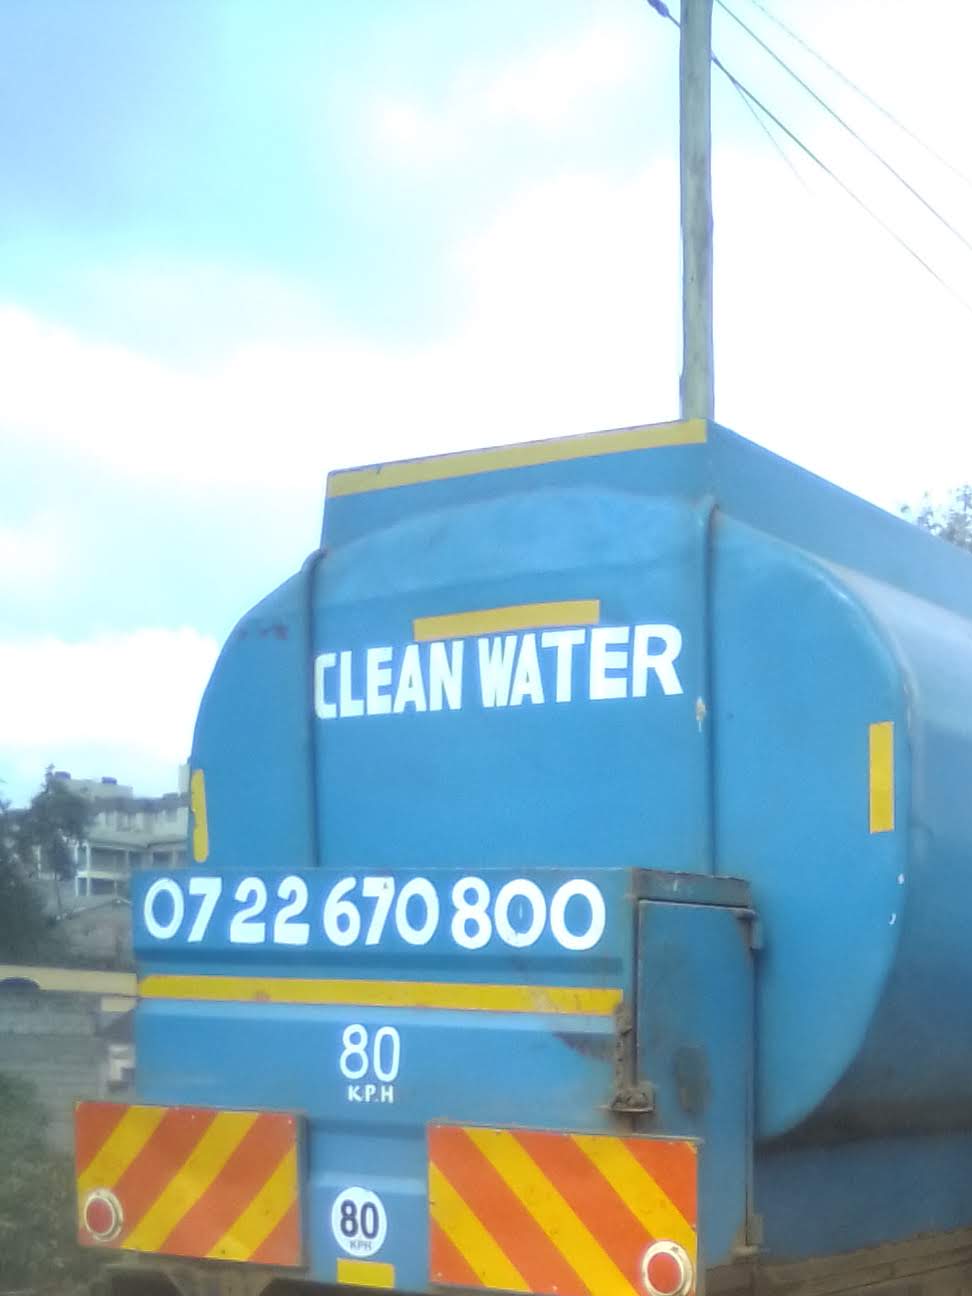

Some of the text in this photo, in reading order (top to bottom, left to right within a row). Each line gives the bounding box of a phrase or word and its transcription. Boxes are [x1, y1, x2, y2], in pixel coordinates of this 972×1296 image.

[314, 623, 684, 720] CLEAN WATER
[340, 1023, 401, 1082] 80
[340, 1199, 380, 1239] 80
[349, 1239, 373, 1251] KPH
